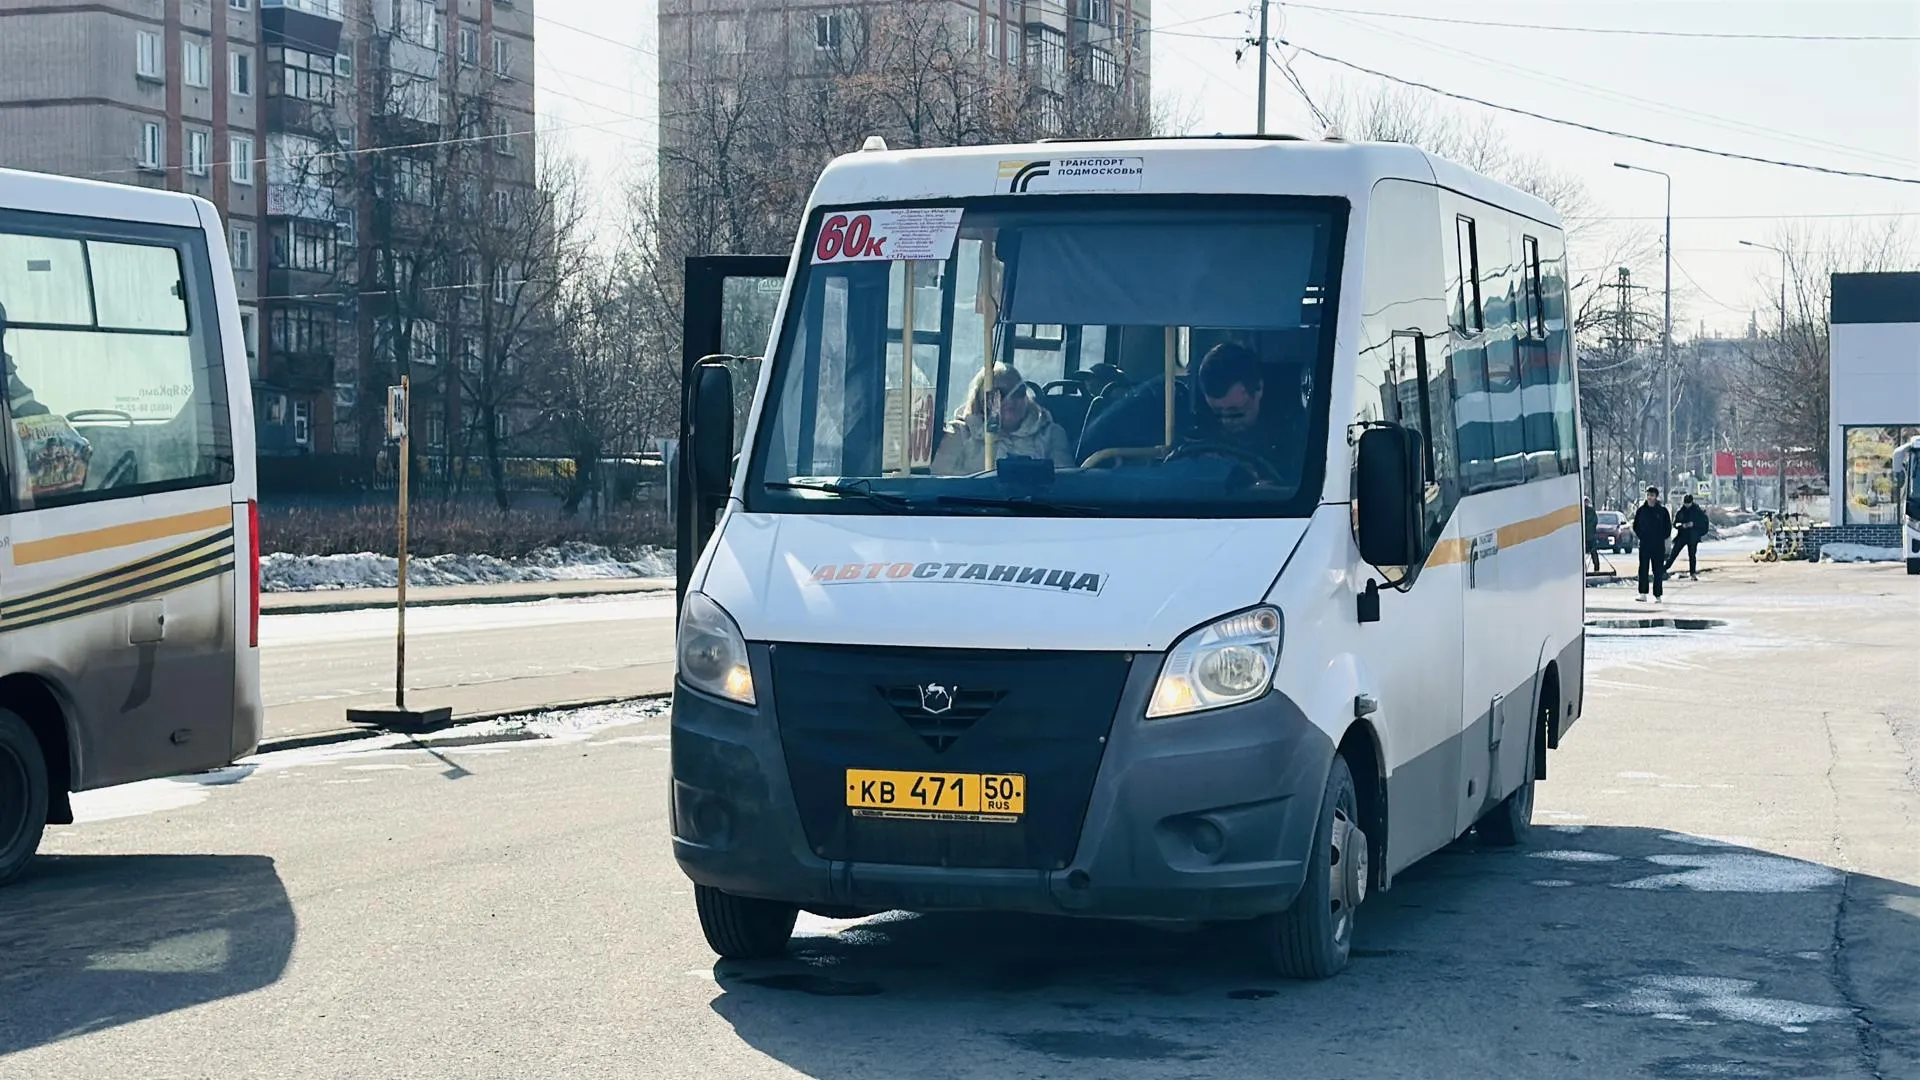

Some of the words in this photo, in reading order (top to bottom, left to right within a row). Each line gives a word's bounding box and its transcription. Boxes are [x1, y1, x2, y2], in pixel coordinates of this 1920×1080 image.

[1060, 159, 1124, 167] ТРАНСПОРТ
[1058, 168, 1143, 176] ПОДМОСКОВЬЯ
[811, 562, 1100, 591] АВТОСТАНИЦА
[861, 780, 895, 804] КВ
[910, 776, 964, 807] 471
[984, 777, 1014, 800] 50
[988, 800, 1010, 810] RUS
